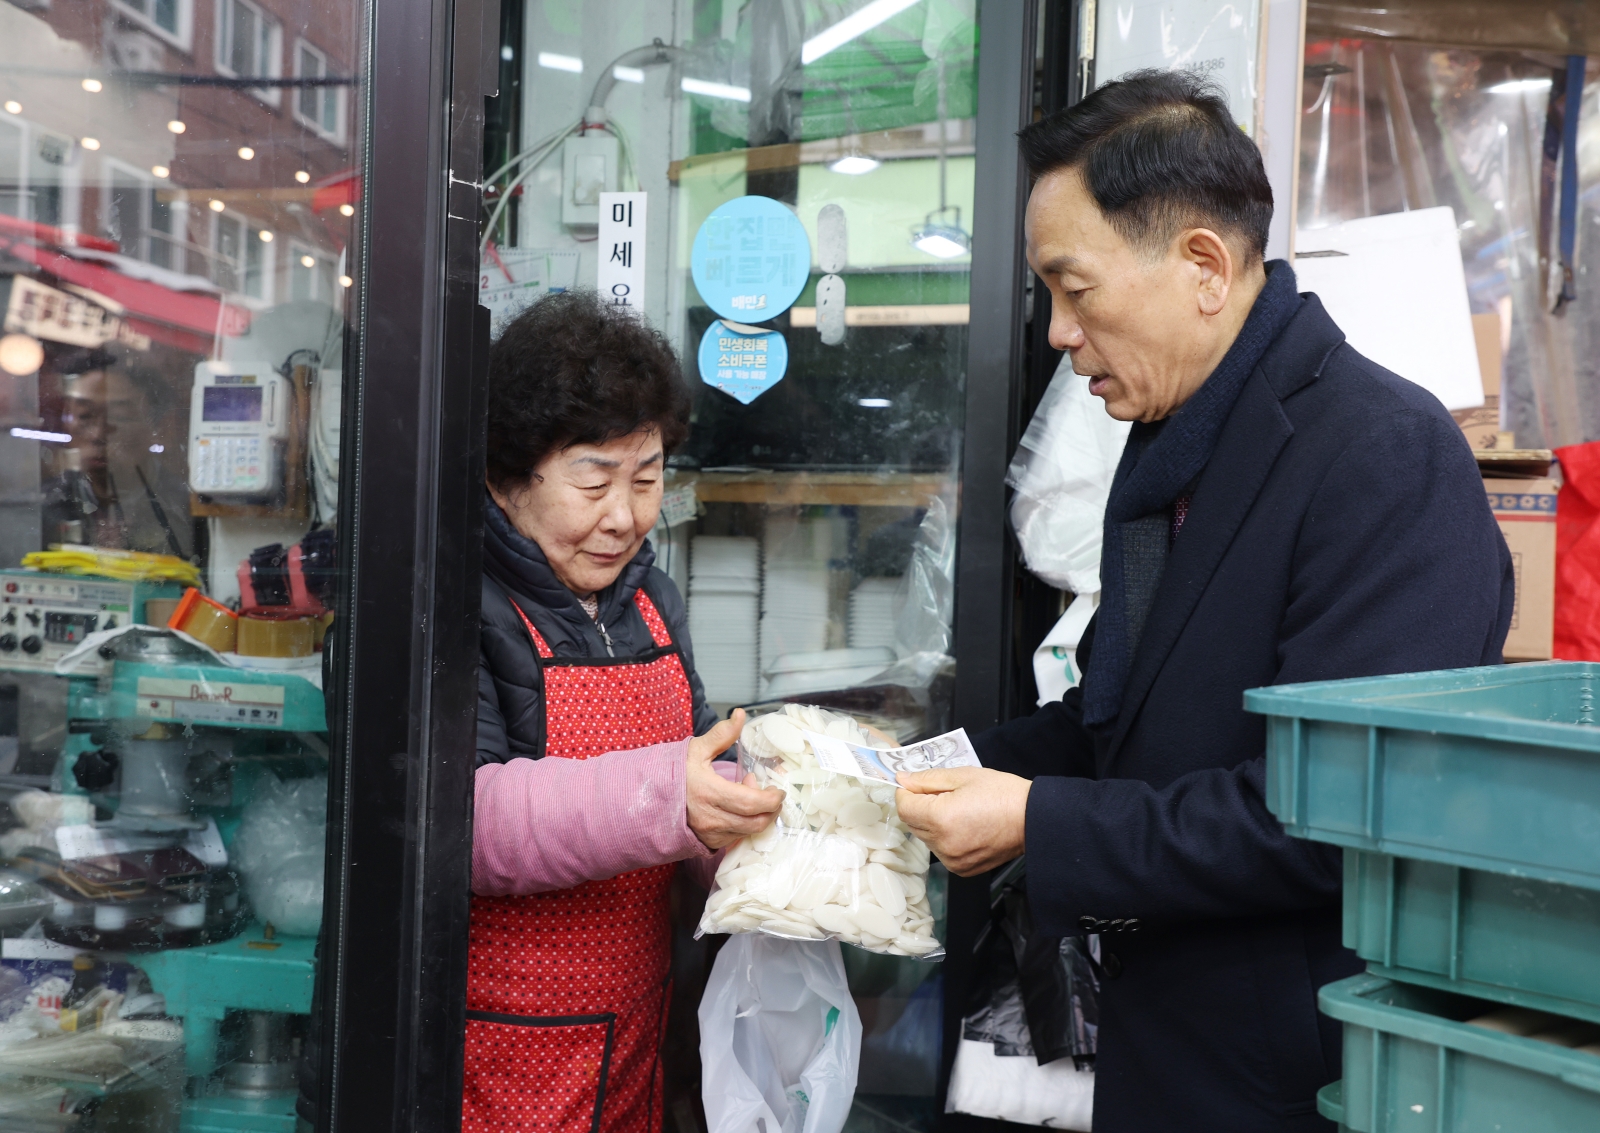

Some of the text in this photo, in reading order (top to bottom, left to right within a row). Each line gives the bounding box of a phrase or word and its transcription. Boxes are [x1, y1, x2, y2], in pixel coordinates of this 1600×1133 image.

[609, 200, 633, 307] 미세요
[705, 253, 797, 287] 빠르게
[718, 337, 768, 352] 민생회복
[717, 353, 767, 369] 소비쿠폰
